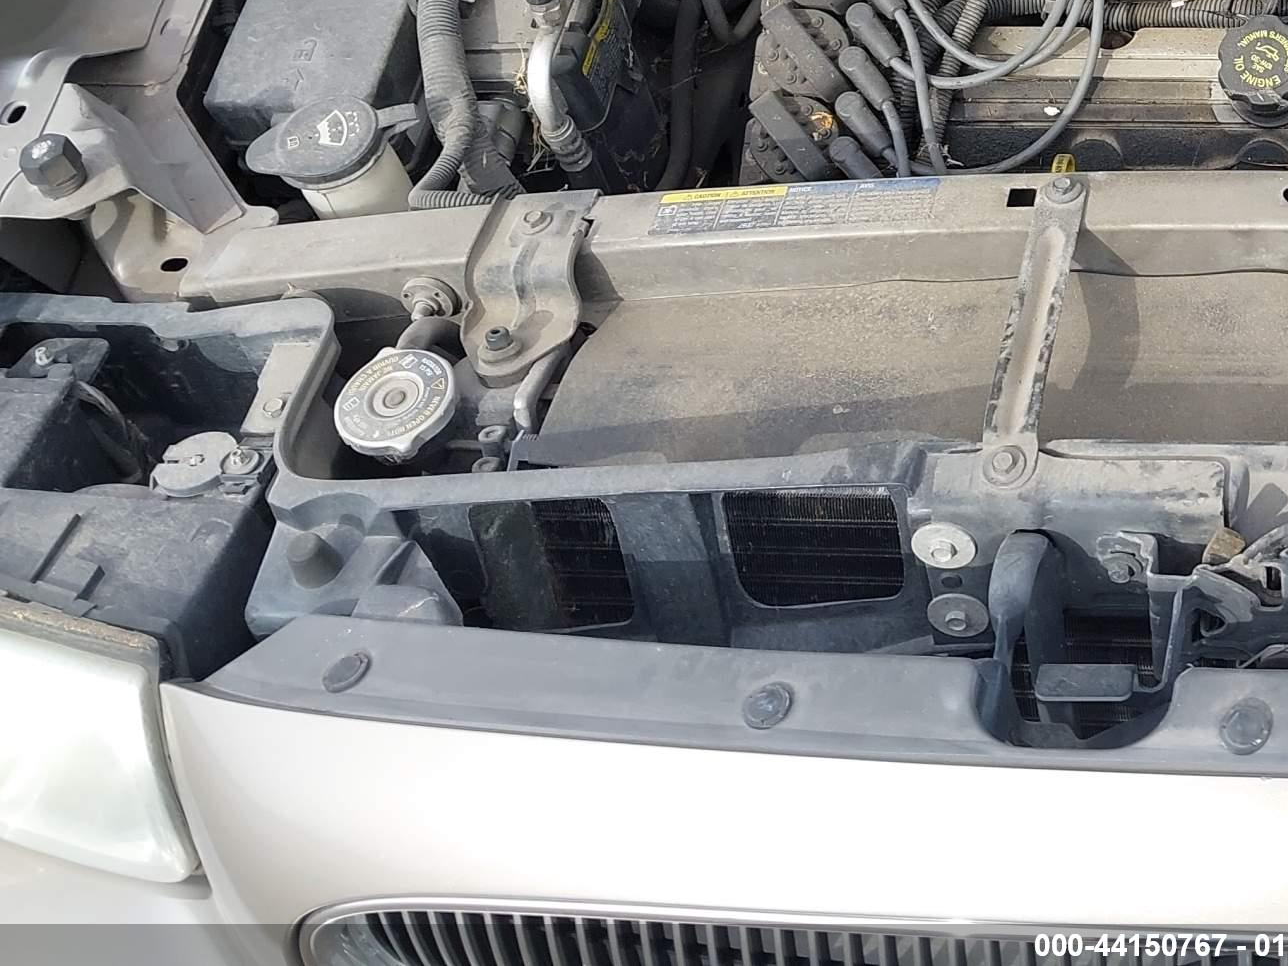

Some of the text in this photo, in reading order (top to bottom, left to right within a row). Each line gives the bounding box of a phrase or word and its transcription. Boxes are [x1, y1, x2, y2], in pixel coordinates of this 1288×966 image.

[1236, 29, 1268, 48] MANUAL
[1233, 55, 1282, 88] ENGINE OIL
[789, 185, 814, 194] NOTICE
[423, 395, 442, 417] NEVER
